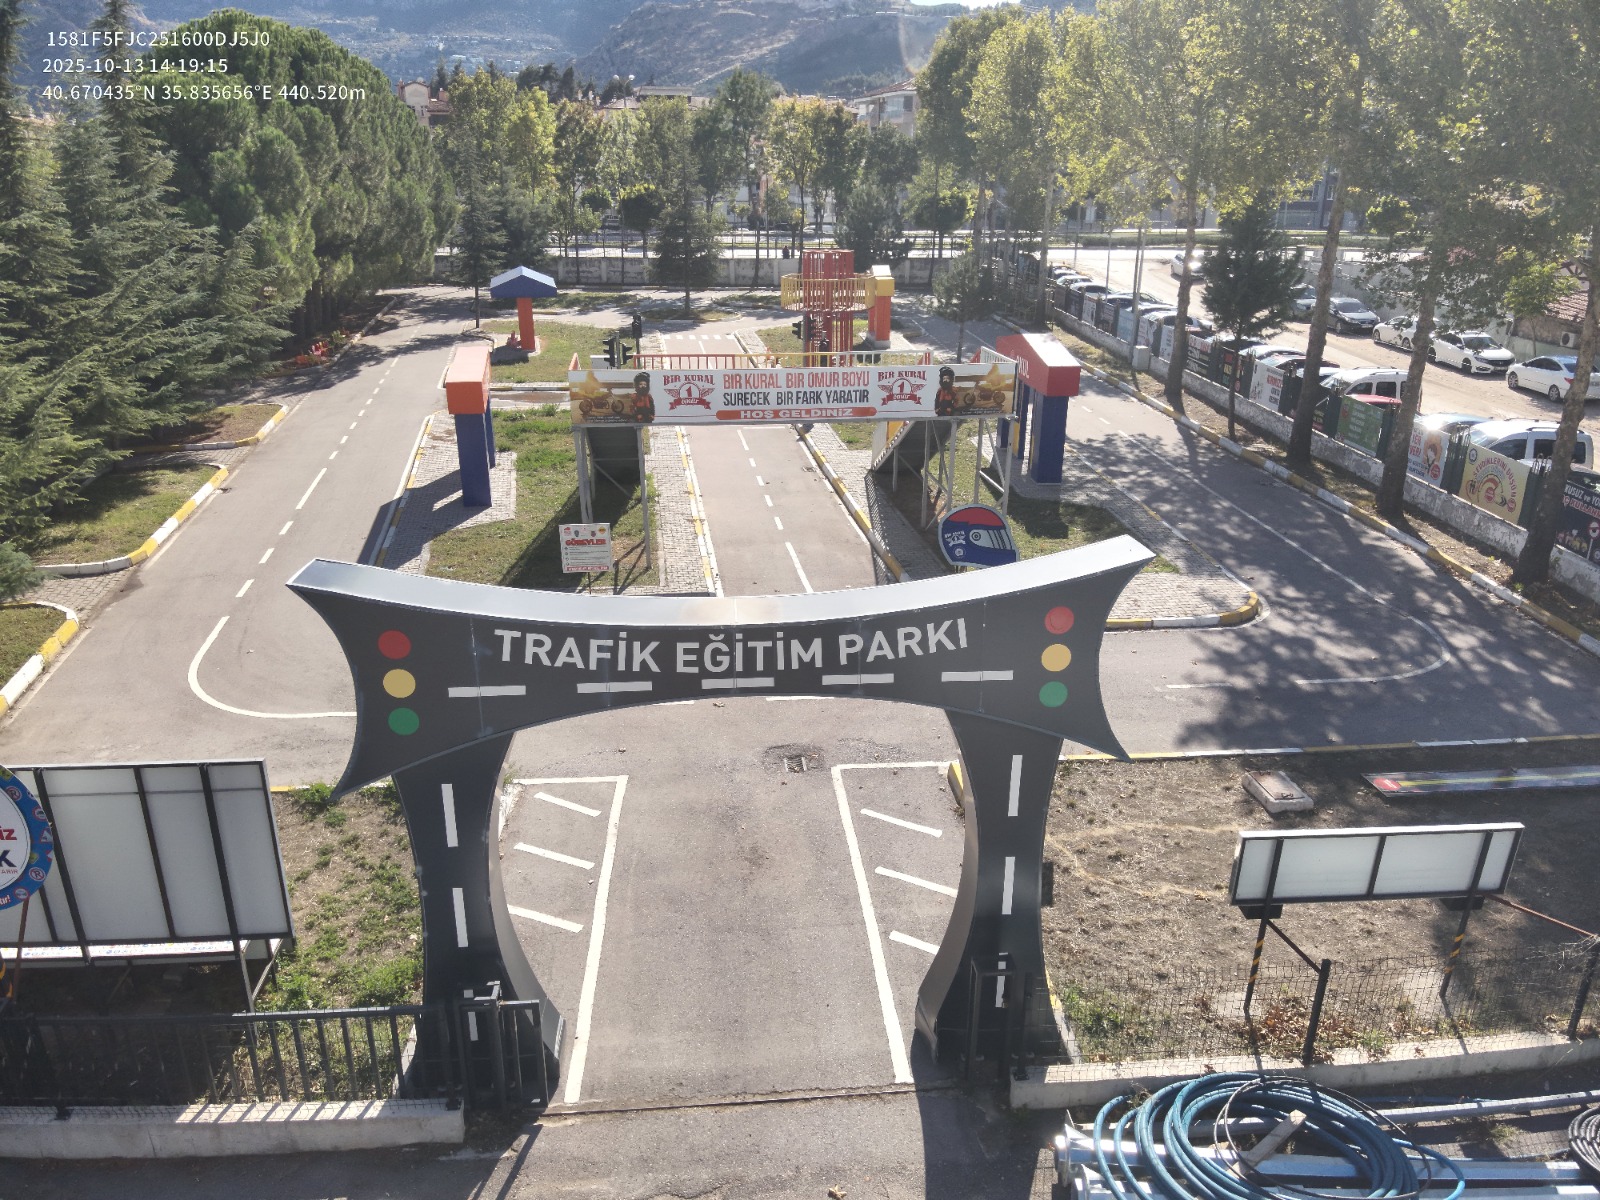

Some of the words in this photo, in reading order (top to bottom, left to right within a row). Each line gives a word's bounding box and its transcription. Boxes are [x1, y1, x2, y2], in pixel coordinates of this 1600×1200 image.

[745, 373, 783, 389] KURAL
[842, 370, 870, 387] BOYU
[796, 390, 823, 405] FARK
[825, 389, 870, 404] YARATIR
[494, 629, 661, 674] TRAFİK
[676, 631, 823, 674] EĞİTİM
[838, 617, 968, 666] PARKI
